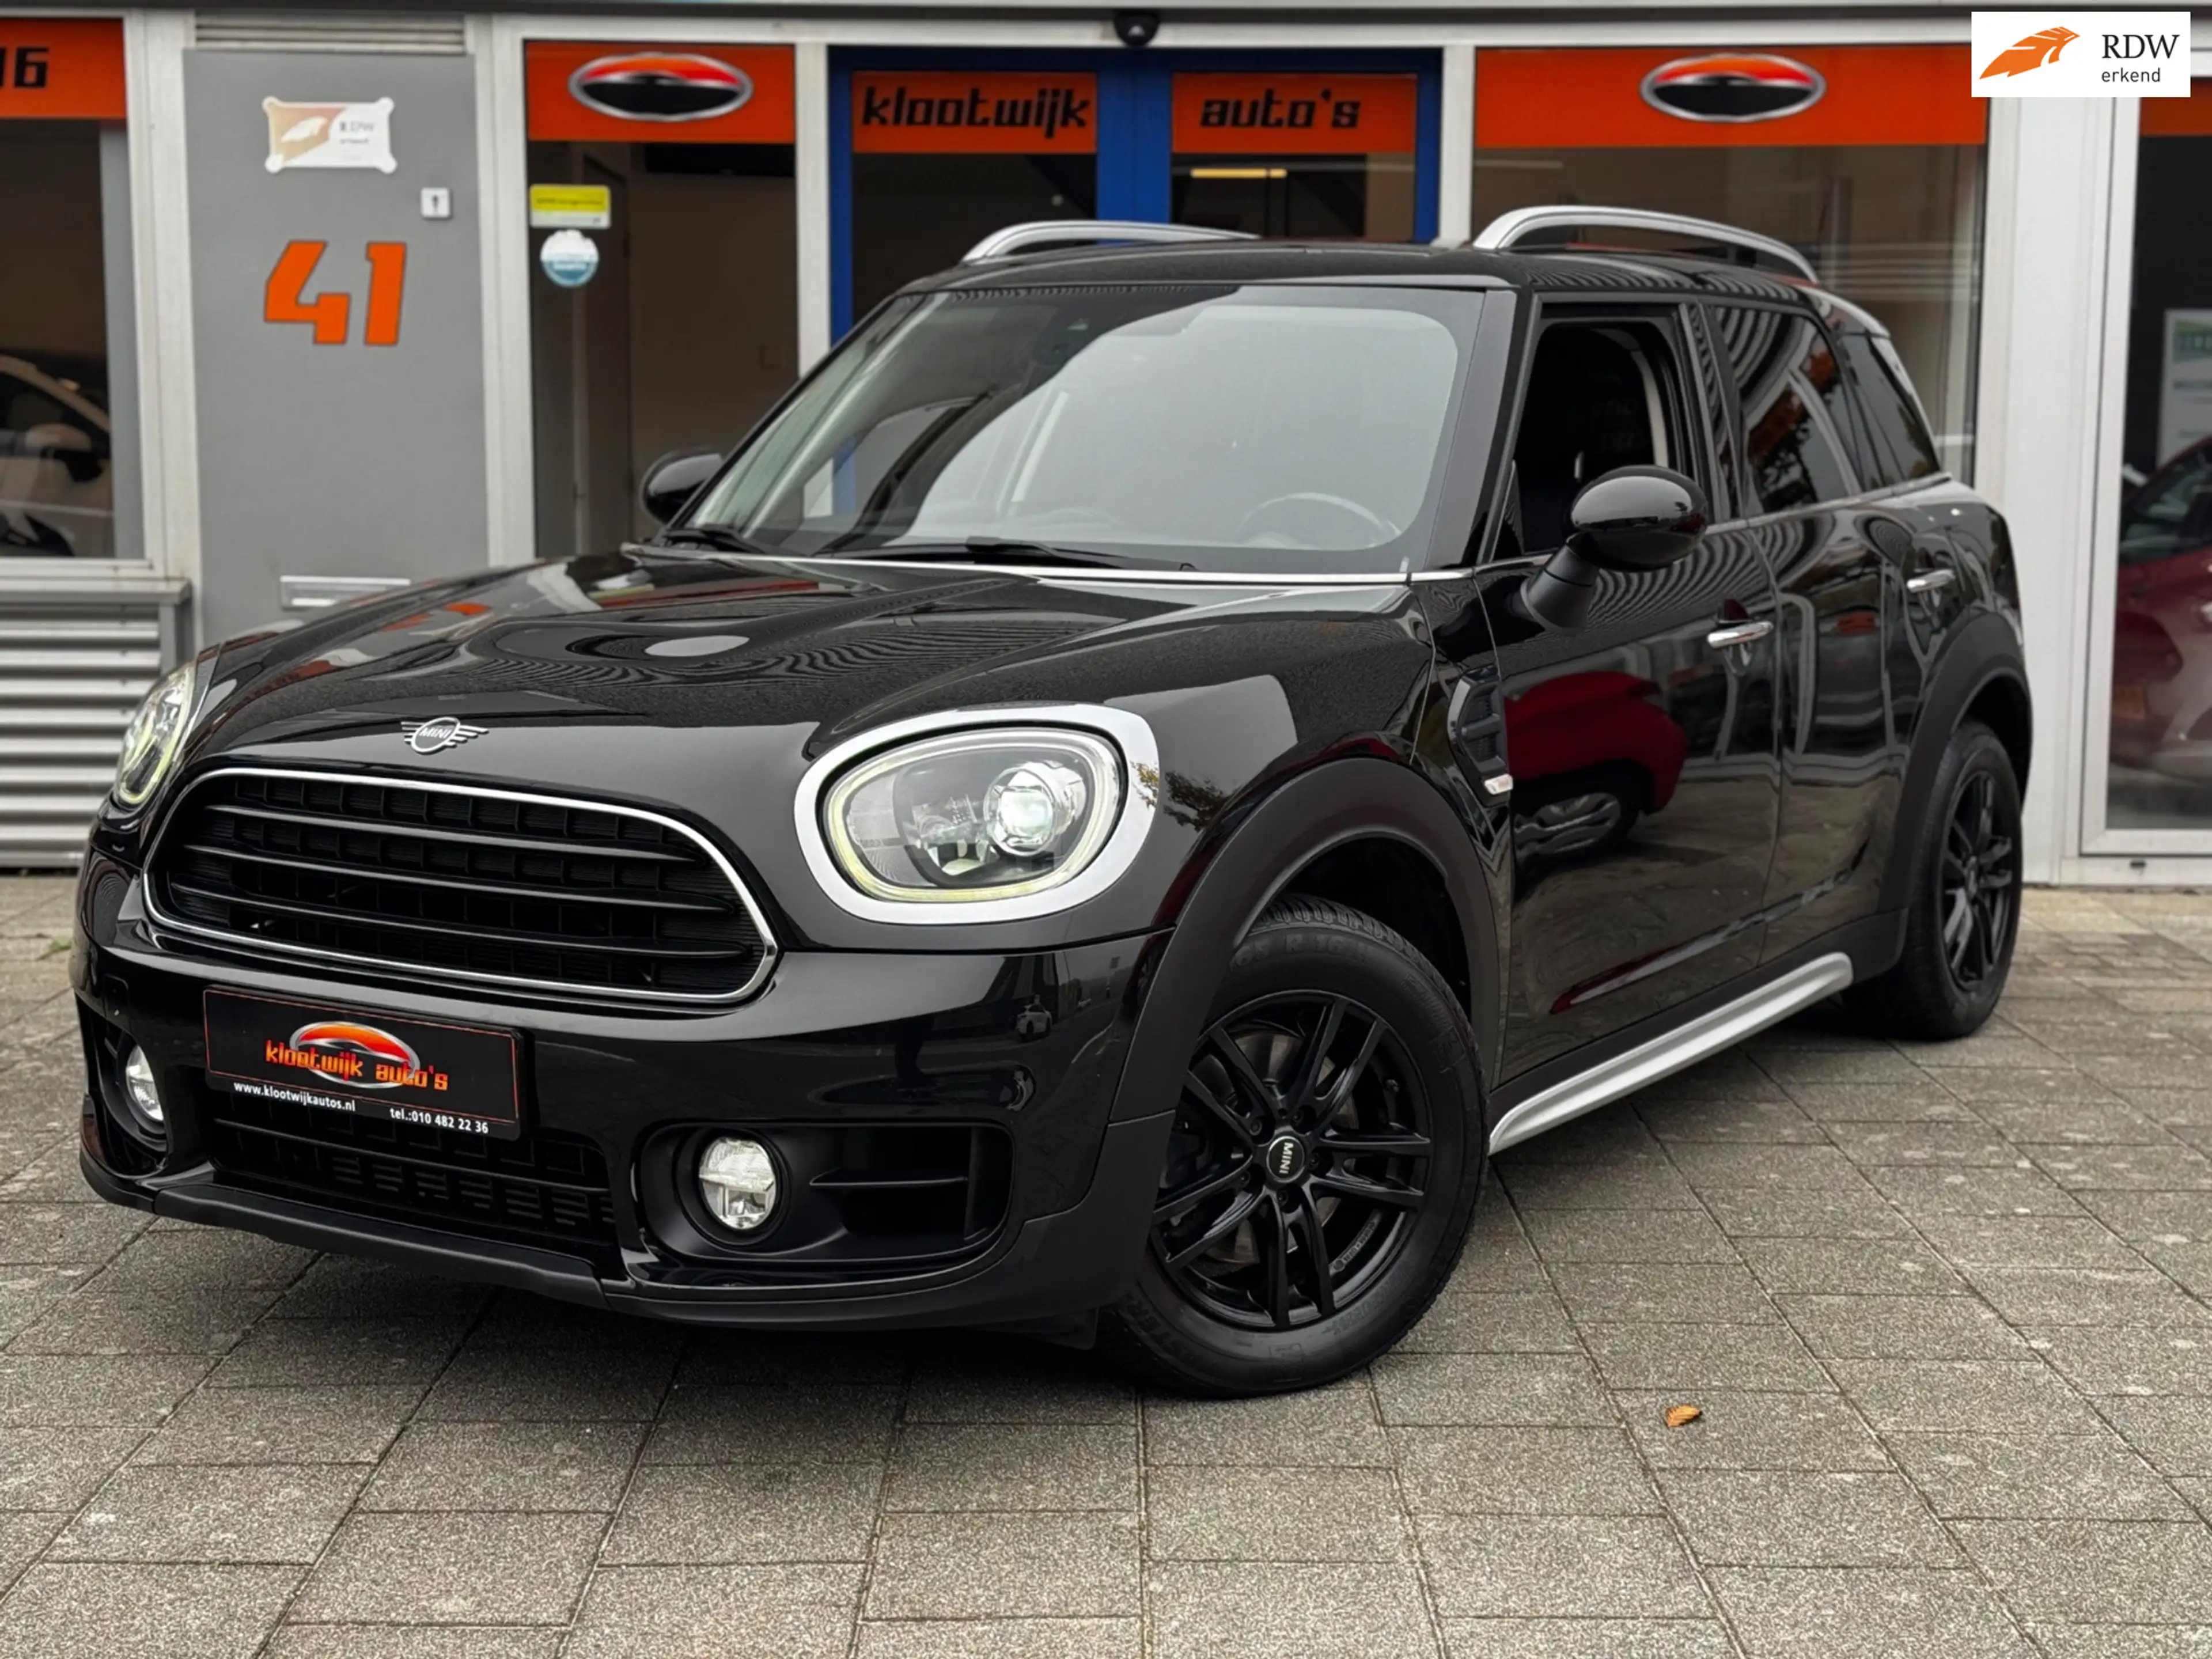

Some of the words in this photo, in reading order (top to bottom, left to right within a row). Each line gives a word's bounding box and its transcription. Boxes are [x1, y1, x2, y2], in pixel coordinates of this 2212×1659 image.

[0, 46, 50, 89] 6
[862, 86, 1090, 138] klootwijk
[1200, 88, 1362, 128] auto's
[263, 239, 407, 346] 41
[419, 726, 453, 740] MINI
[266, 1040, 364, 1081] klootwijk
[376, 1060, 448, 1091] auto's
[233, 1082, 356, 1112] www.klootwijkautos.nl
[389, 1108, 431, 1124] tel.:010
[435, 1114, 454, 1128] 482
[458, 1118, 472, 1131] 22
[475, 1121, 488, 1134] 36
[1279, 1142, 1294, 1174] MINI
